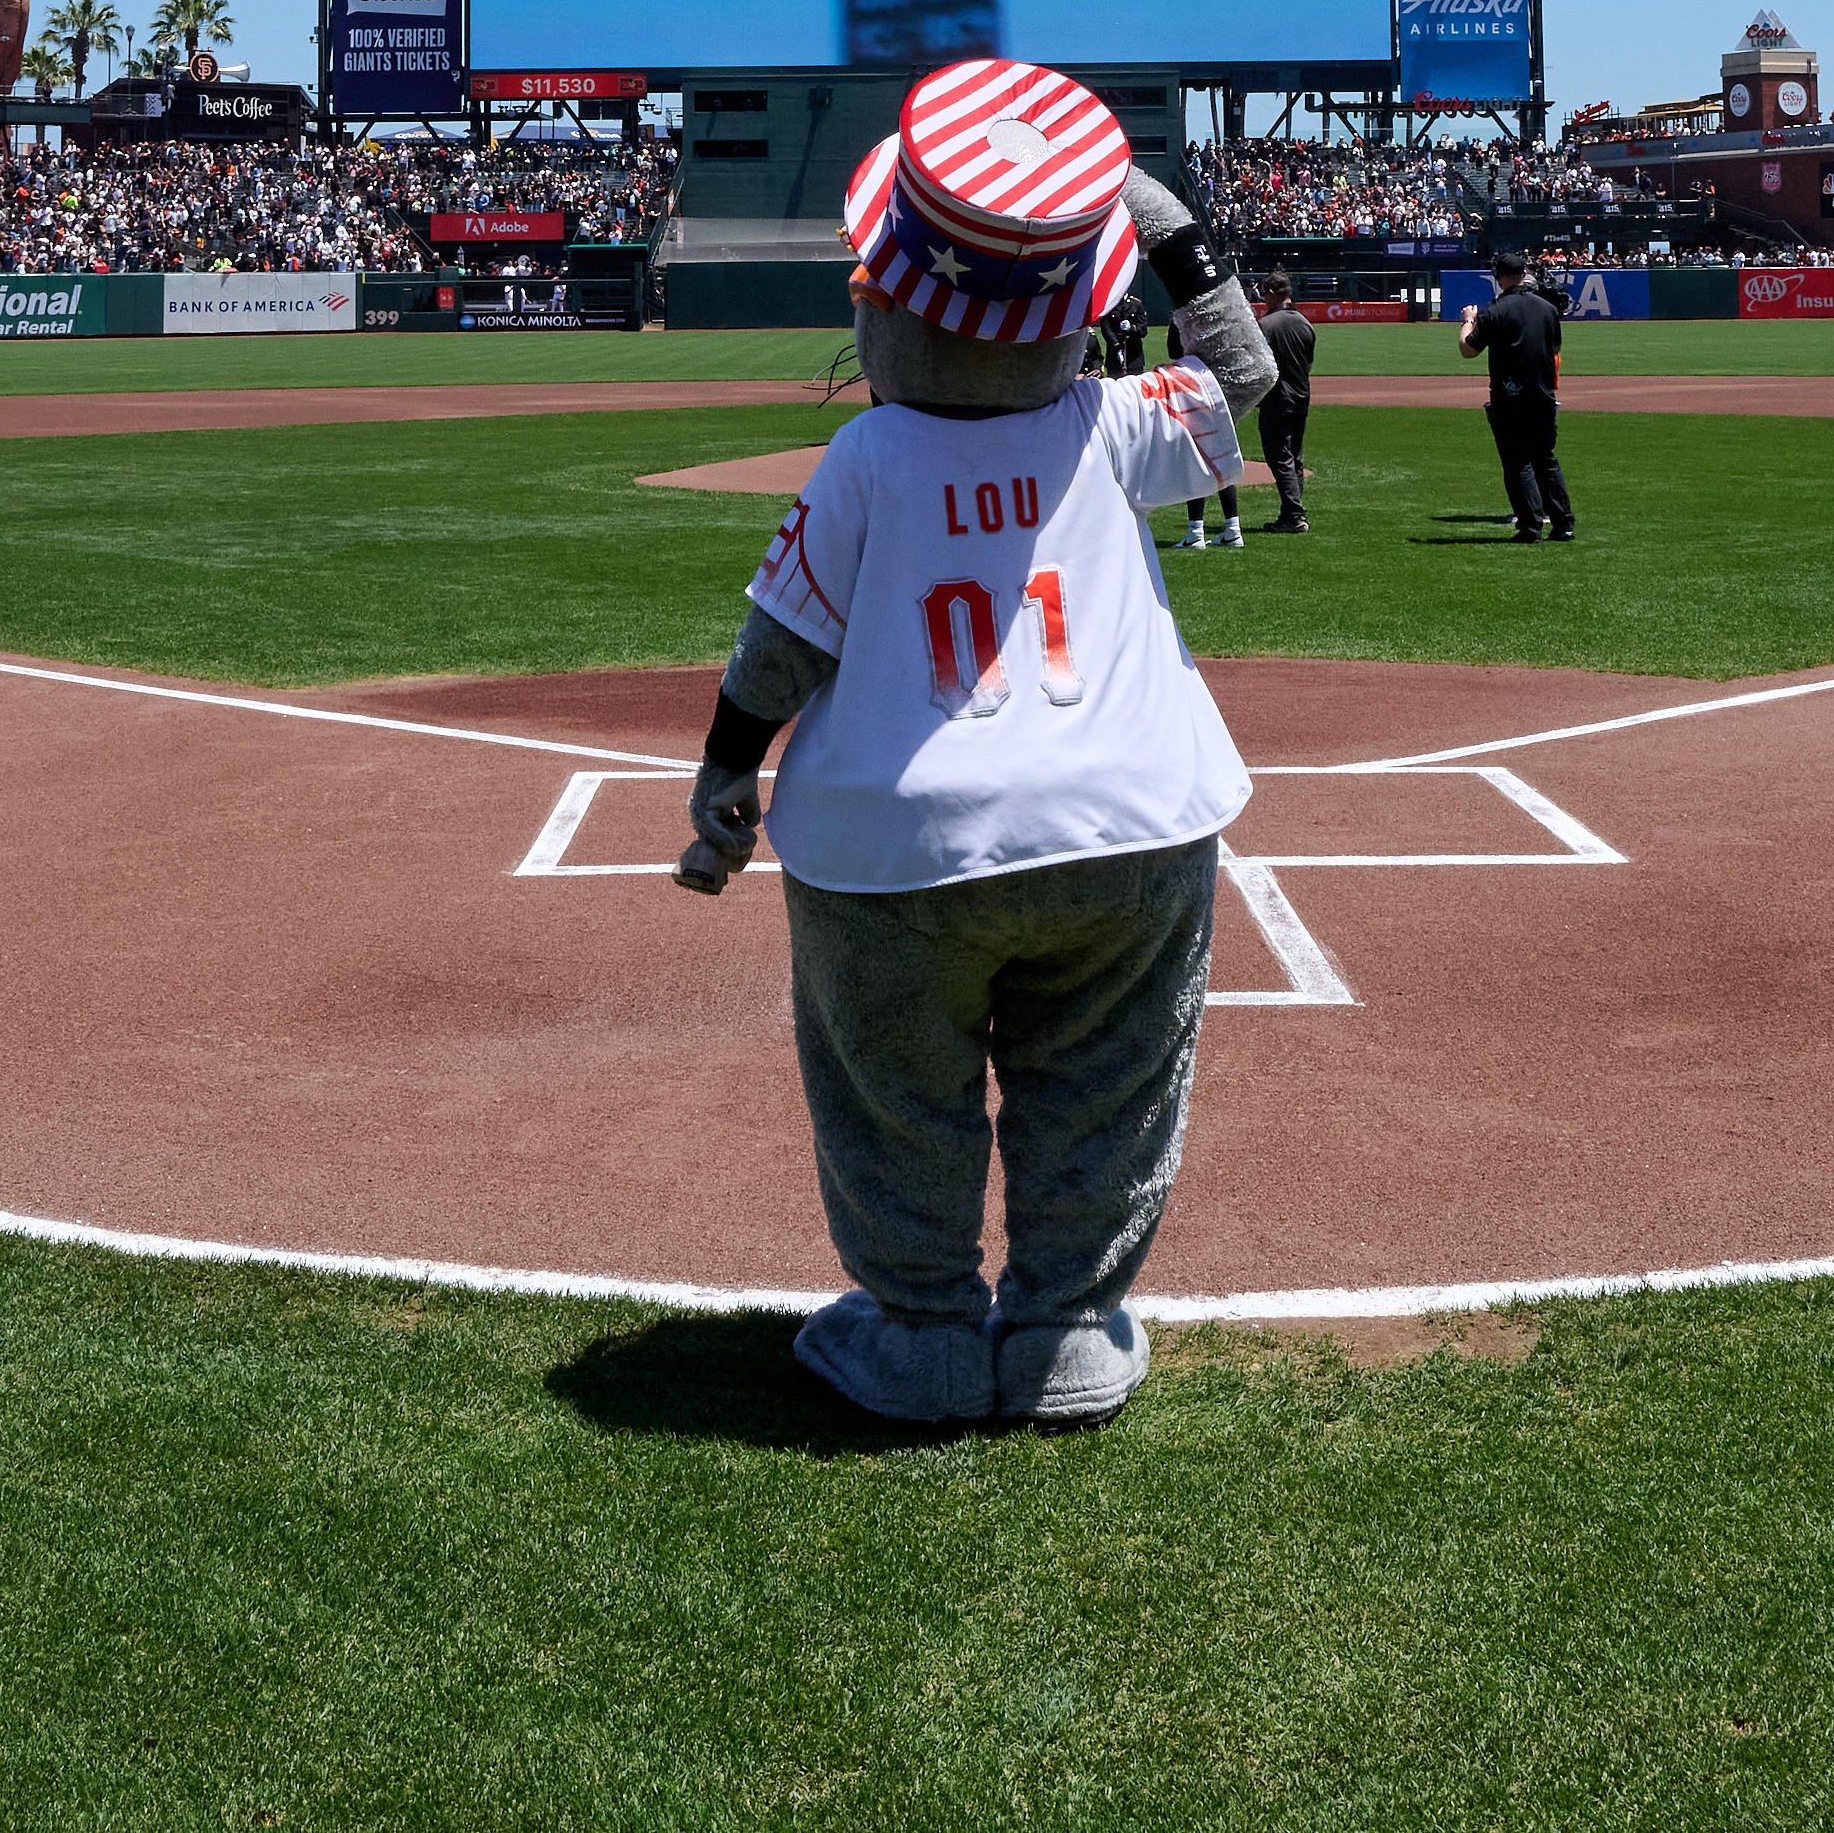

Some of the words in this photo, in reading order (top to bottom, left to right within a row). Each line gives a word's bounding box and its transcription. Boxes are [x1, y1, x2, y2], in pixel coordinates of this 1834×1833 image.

[1410, 23, 1515, 34] AIRLINES
[1746, 23, 1787, 39] Coors
[349, 29, 384, 48] 100%
[388, 28, 446, 47] VERIFIED
[1751, 37, 1783, 47] LIGHT
[344, 52, 392, 72] GIANTS
[395, 51, 450, 71] TICKETS
[521, 78, 595, 96] $11,530
[198, 95, 231, 116] Peet's
[233, 97, 273, 120] Coffee
[1414, 90, 1471, 112] Coors
[490, 222, 529, 233] Adobe
[1750, 278, 1783, 294] AAA
[169, 302, 213, 313] BANK
[219, 301, 238, 312] OF
[243, 300, 315, 313] AMERICA
[1344, 308, 1366, 317] PURE
[365, 310, 399, 326] 399
[477, 316, 525, 327] KONICA
[528, 315, 581, 327] MINOLTA
[18, 319, 73, 335] Rental
[944, 477, 1039, 536] LOU
[917, 563, 1087, 721] 01
